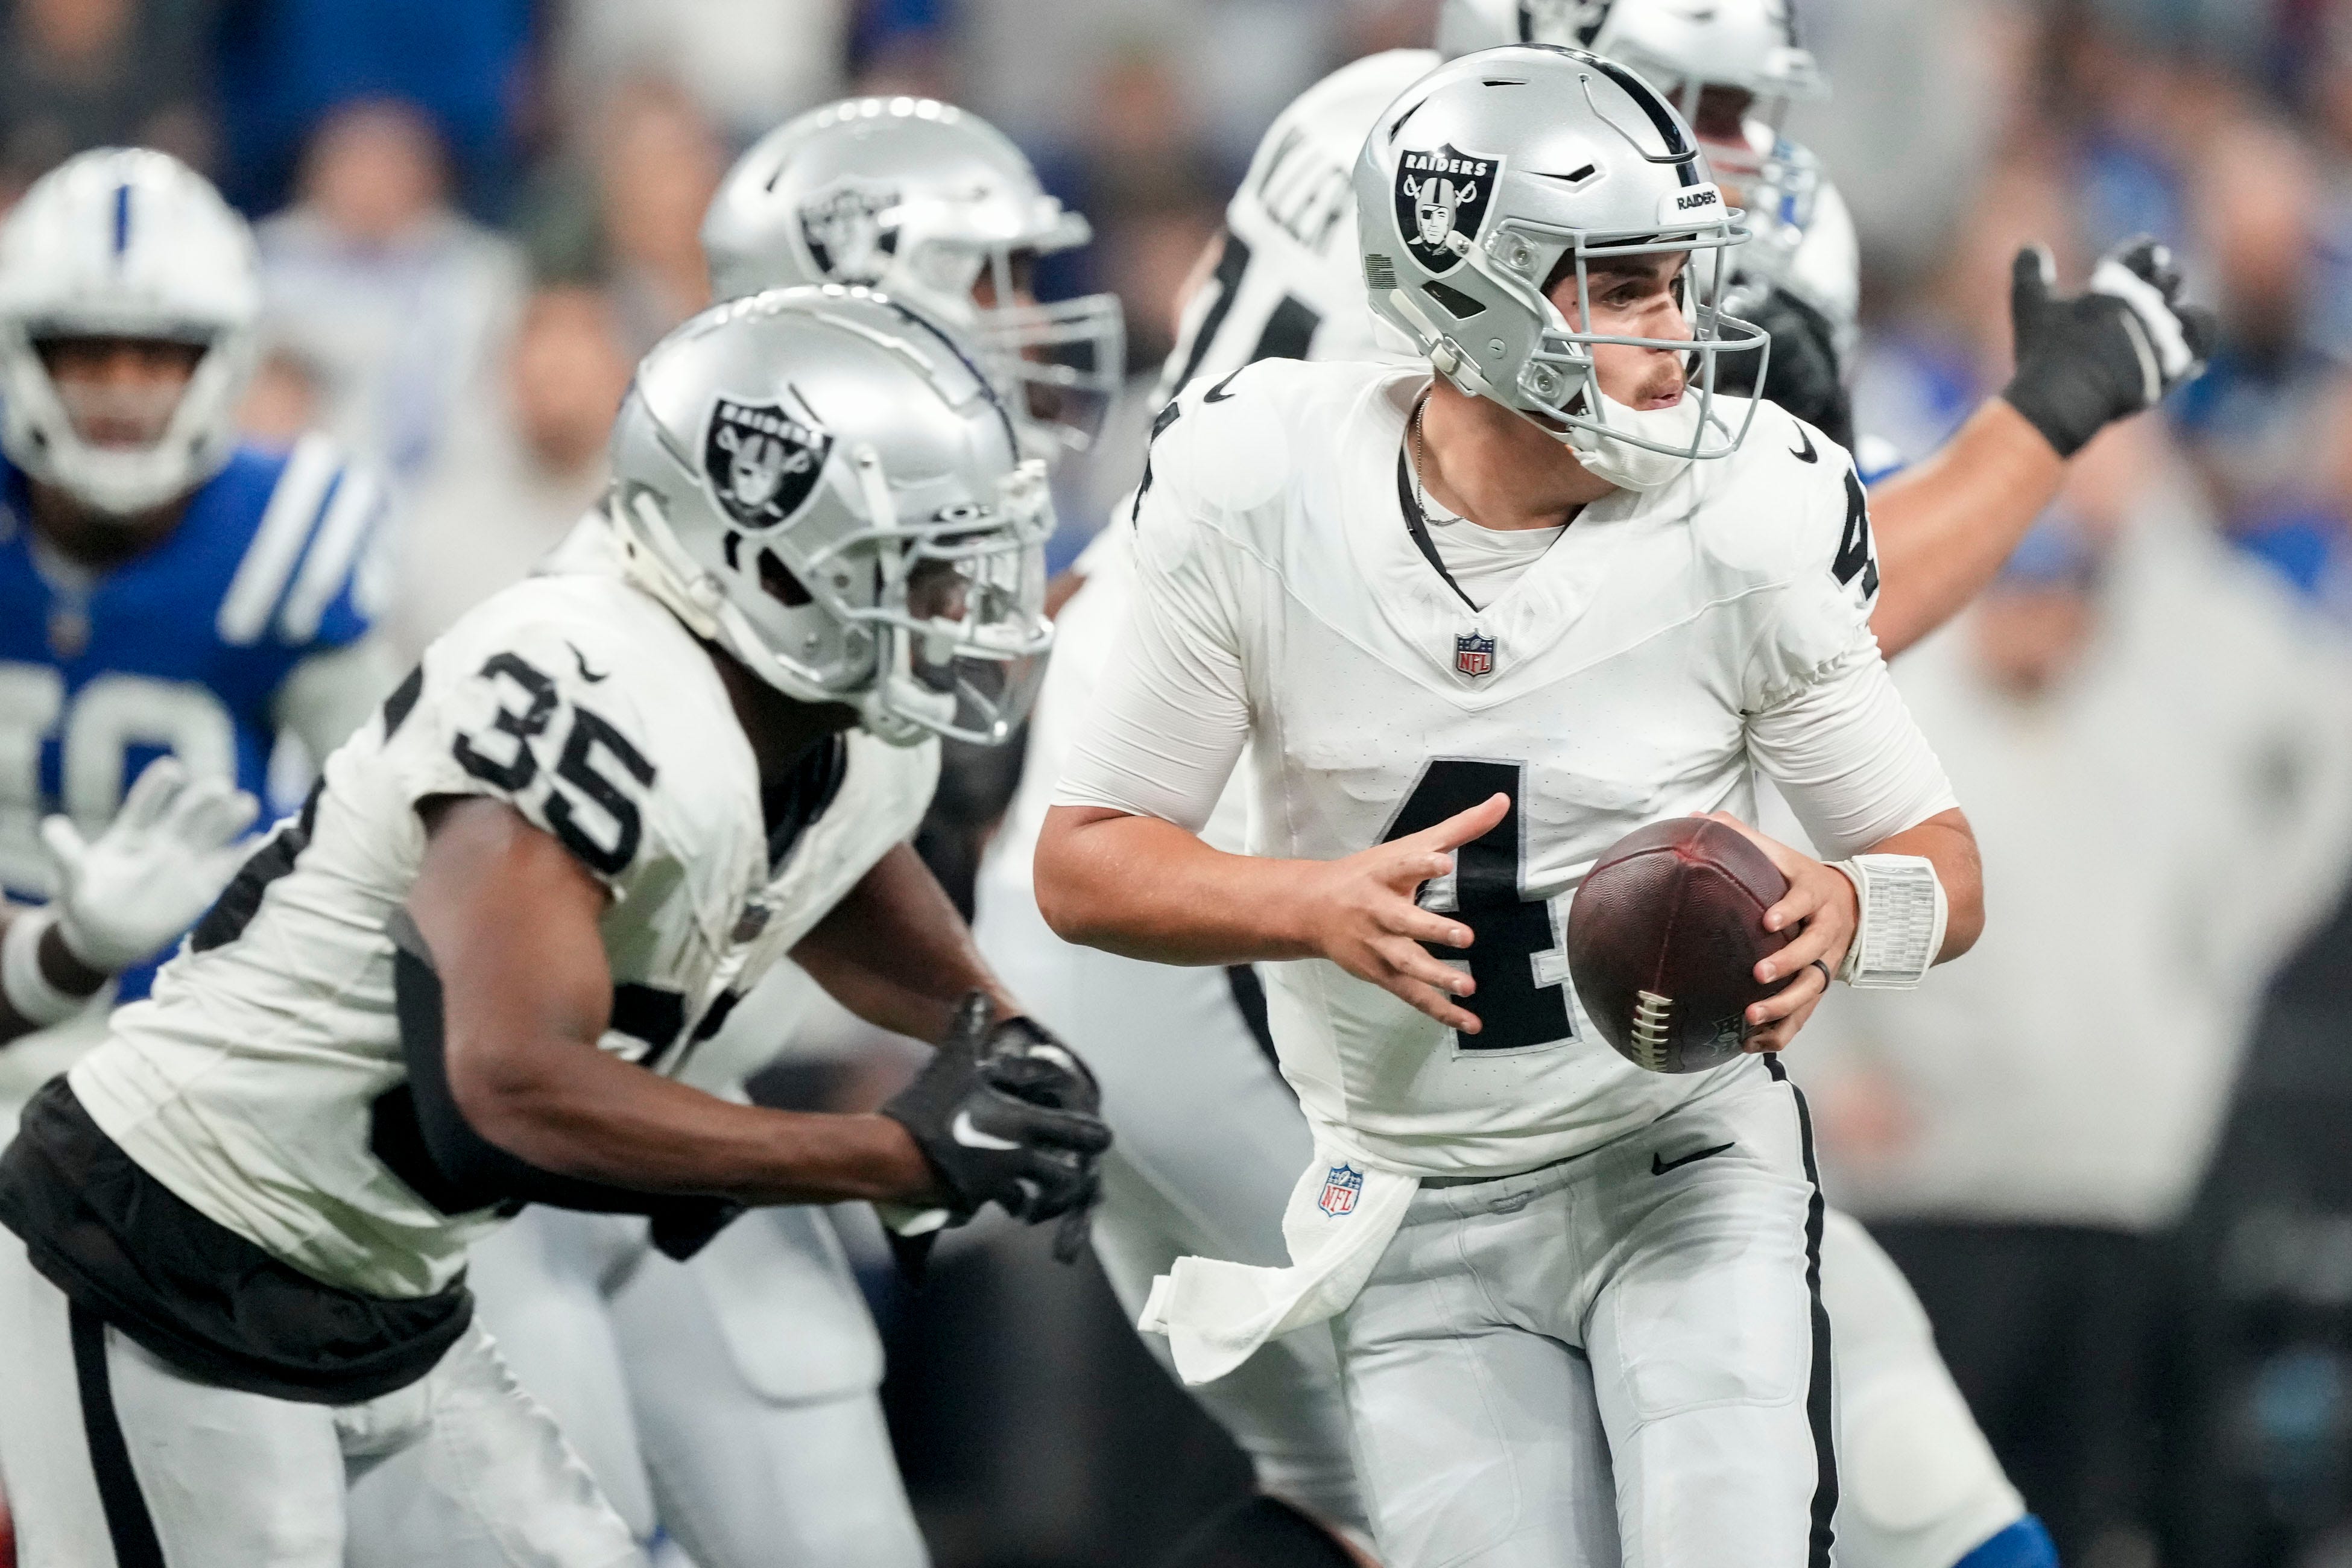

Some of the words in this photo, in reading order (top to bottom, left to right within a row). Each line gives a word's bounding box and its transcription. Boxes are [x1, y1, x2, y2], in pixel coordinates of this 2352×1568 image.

[1405, 154, 1488, 177] RAIDERS
[1459, 654, 1490, 673] NFL
[451, 650, 659, 876] 35
[1370, 755, 1584, 1061] 4
[1321, 1185, 1353, 1212] NFL
